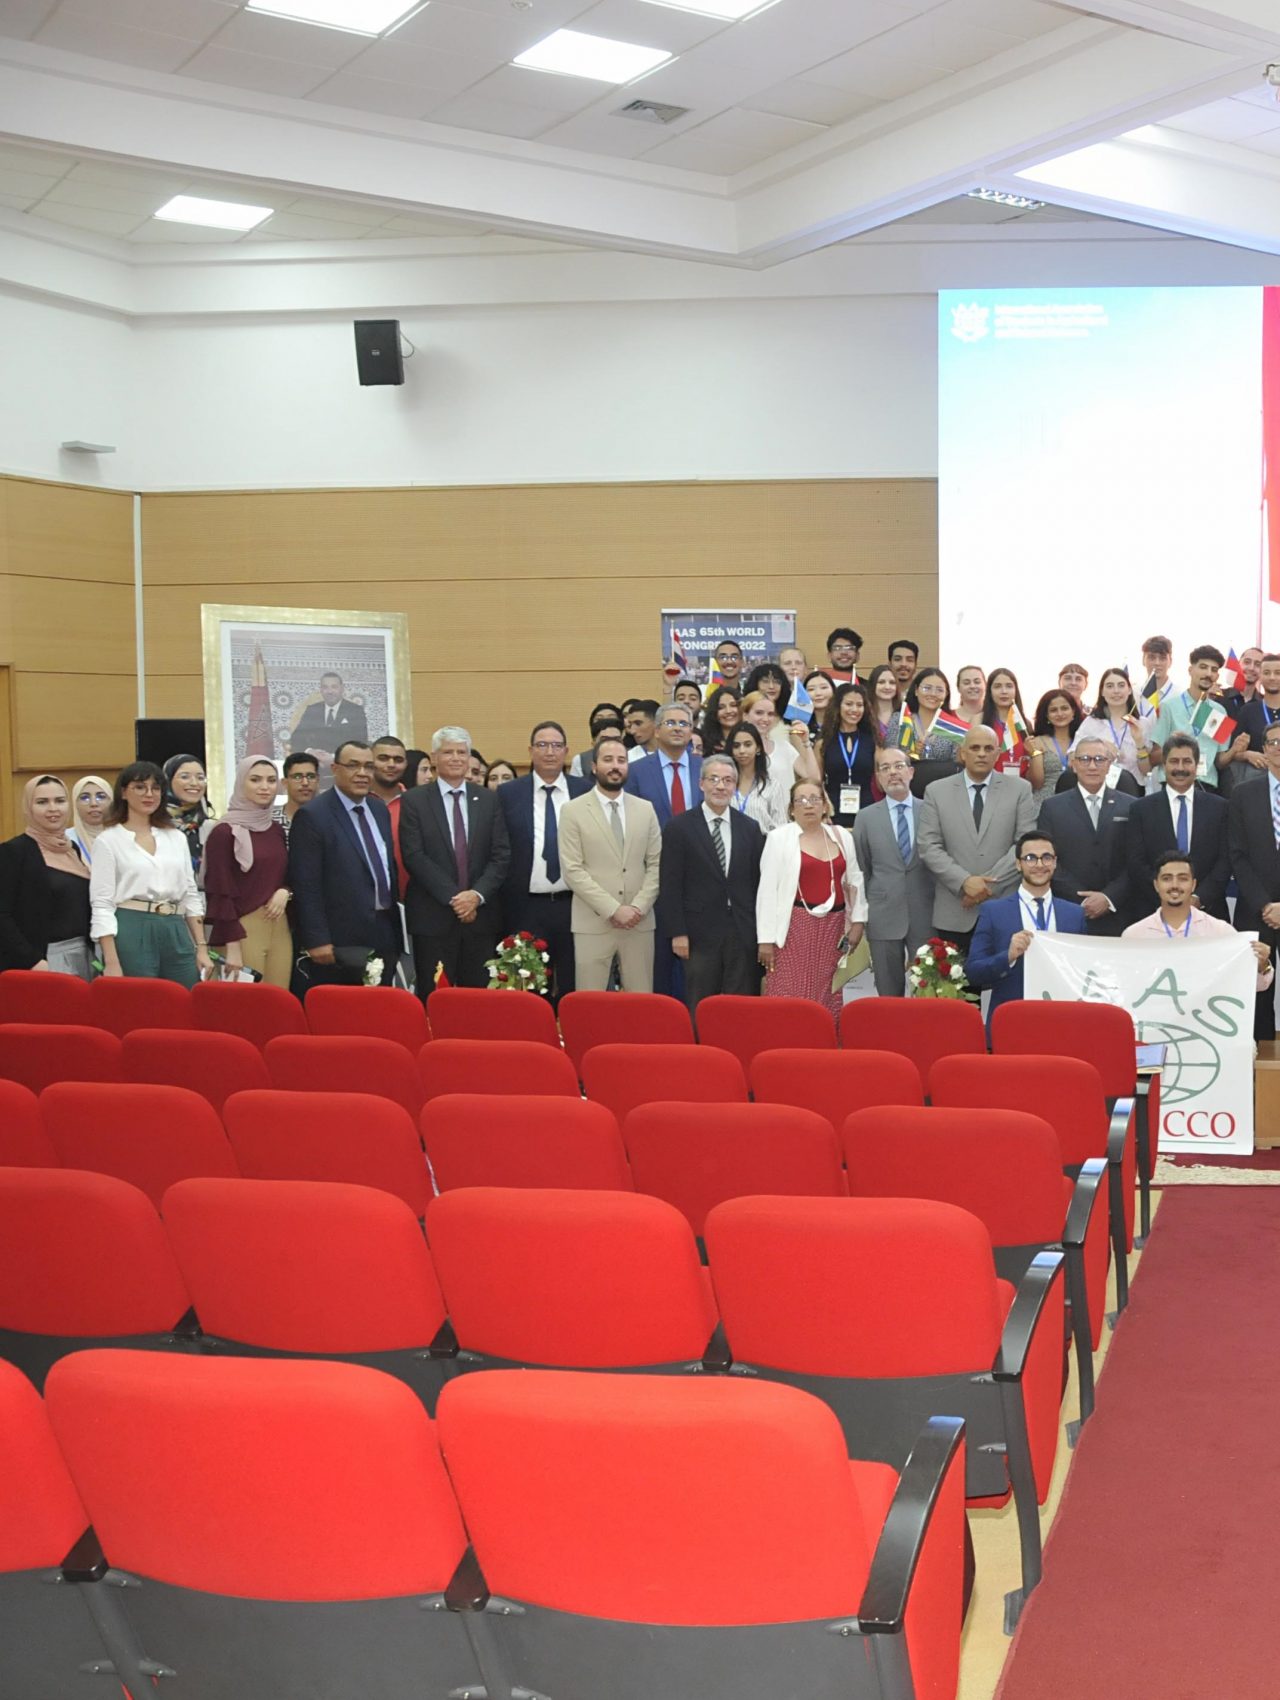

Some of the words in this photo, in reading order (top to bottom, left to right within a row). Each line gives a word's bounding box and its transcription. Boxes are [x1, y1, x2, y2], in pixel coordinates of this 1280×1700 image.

[670, 628, 696, 638] IAAS
[700, 627, 725, 636] 65th
[726, 627, 765, 637] WORLD
[740, 641, 766, 650] 2022
